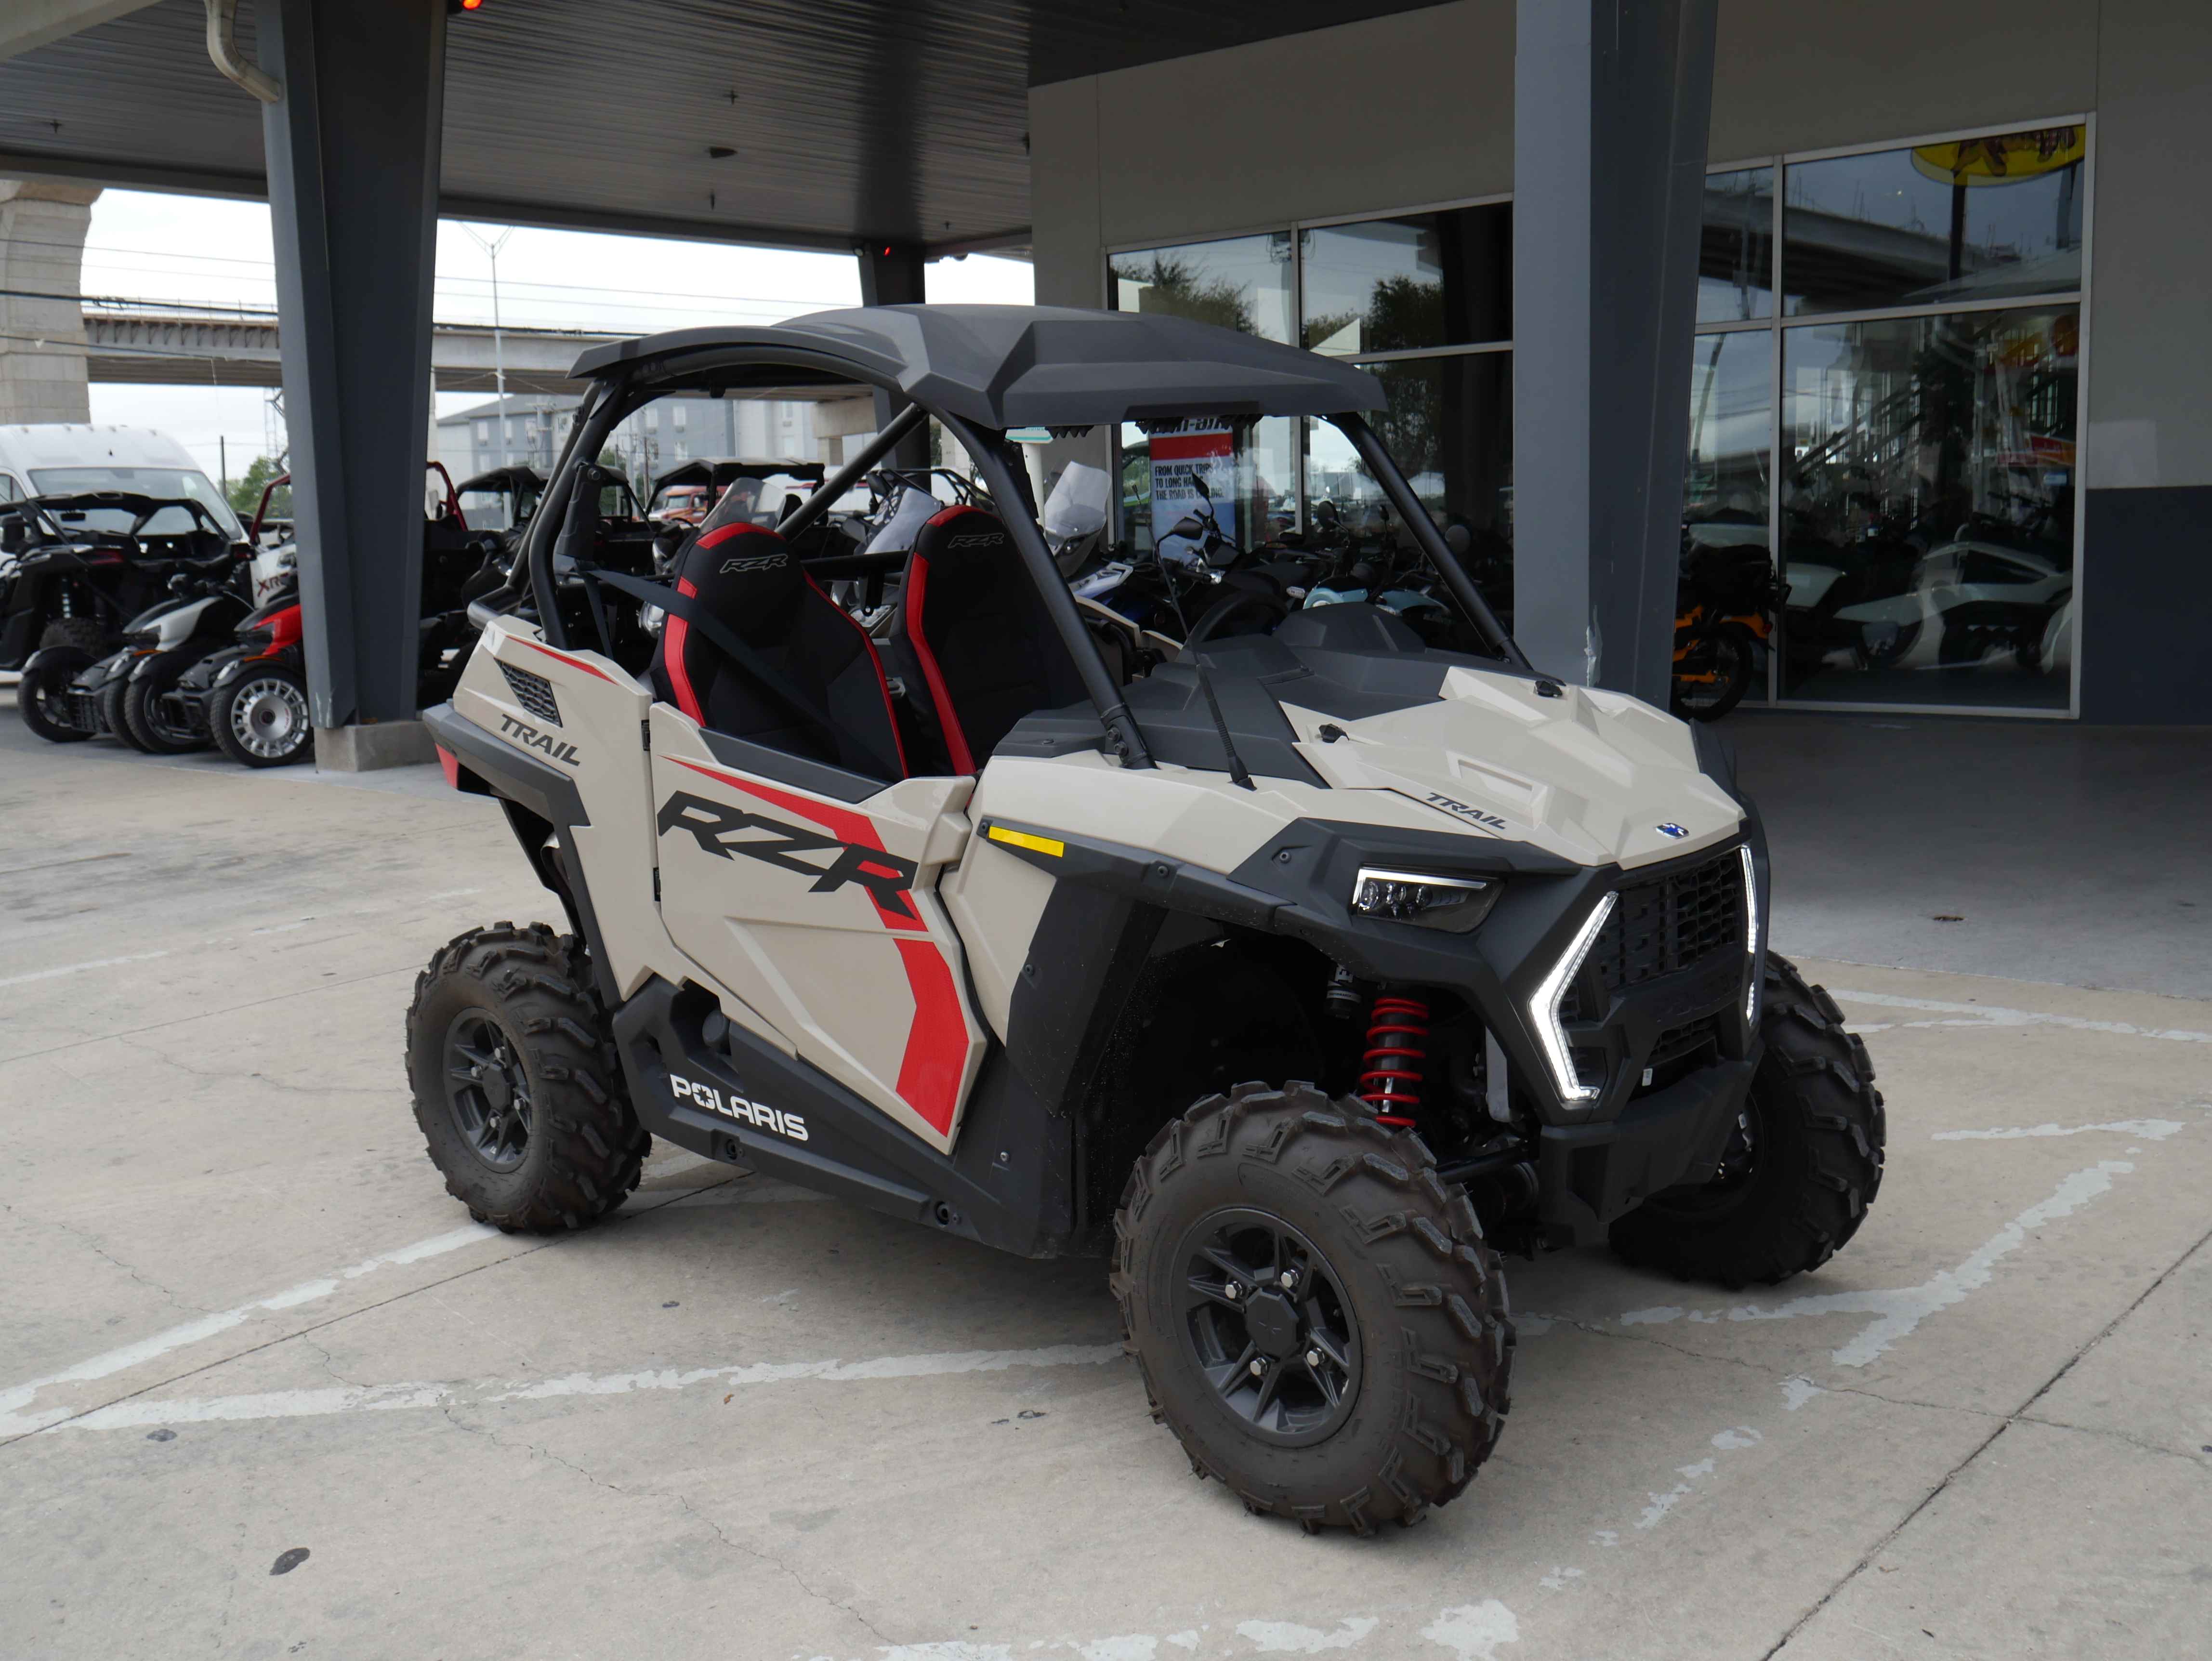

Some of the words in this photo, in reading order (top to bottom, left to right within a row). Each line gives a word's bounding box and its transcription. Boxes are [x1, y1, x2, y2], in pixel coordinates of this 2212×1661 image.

[1155, 465, 1172, 476] FROM
[1174, 464, 1194, 475] QUICK
[1195, 463, 1213, 474] TRIPS
[1156, 477, 1163, 488] TO
[1165, 477, 1181, 488] LONG
[1156, 490, 1168, 501] THE
[1169, 488, 1185, 500] ROAD
[1187, 488, 1194, 499] IS
[1196, 486, 1224, 499] CING.
[948, 533, 1004, 549] RZR
[719, 553, 788, 574] RZR
[501, 713, 580, 766] TRAIL
[1426, 792, 1506, 830] TRAIL
[657, 790, 919, 921] RZR
[1655, 971, 1741, 1022] POLARIS
[670, 1074, 809, 1141] POLARIS
